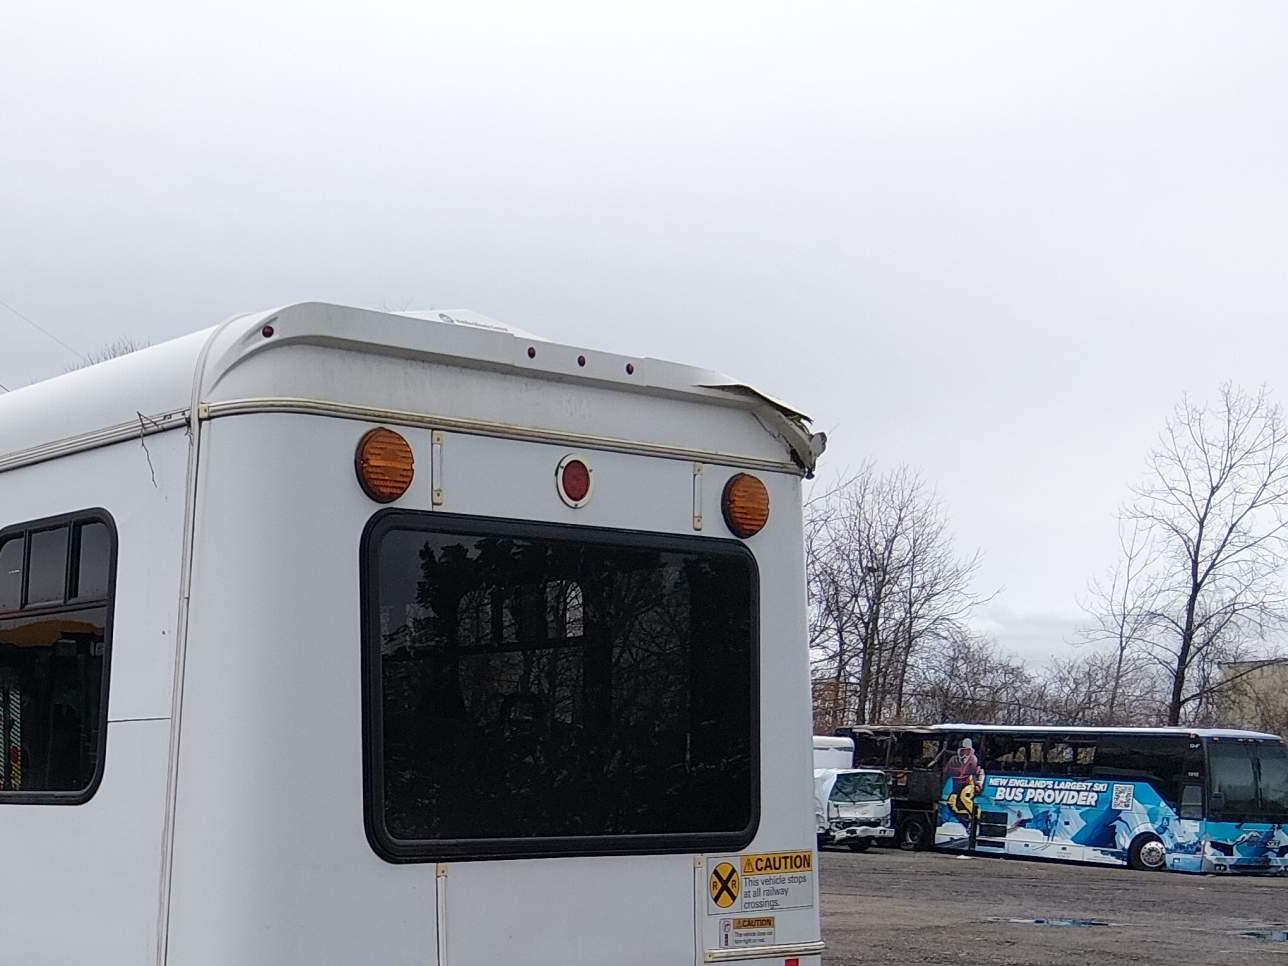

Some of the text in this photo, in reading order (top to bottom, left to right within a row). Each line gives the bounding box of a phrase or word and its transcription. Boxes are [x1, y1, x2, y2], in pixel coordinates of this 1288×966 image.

[989, 778, 1108, 791] NEW ENGLAND'S LARGEST SKI
[995, 787, 1098, 806] BUS PROVIDER
[755, 854, 811, 871] CAUTION
[712, 881, 718, 890] R
[731, 879, 737, 888] R
[744, 874, 807, 887] This vehicle stops
[744, 886, 789, 898] at all railway
[744, 898, 780, 910] crossings.
[742, 919, 772, 928] CAUTION
